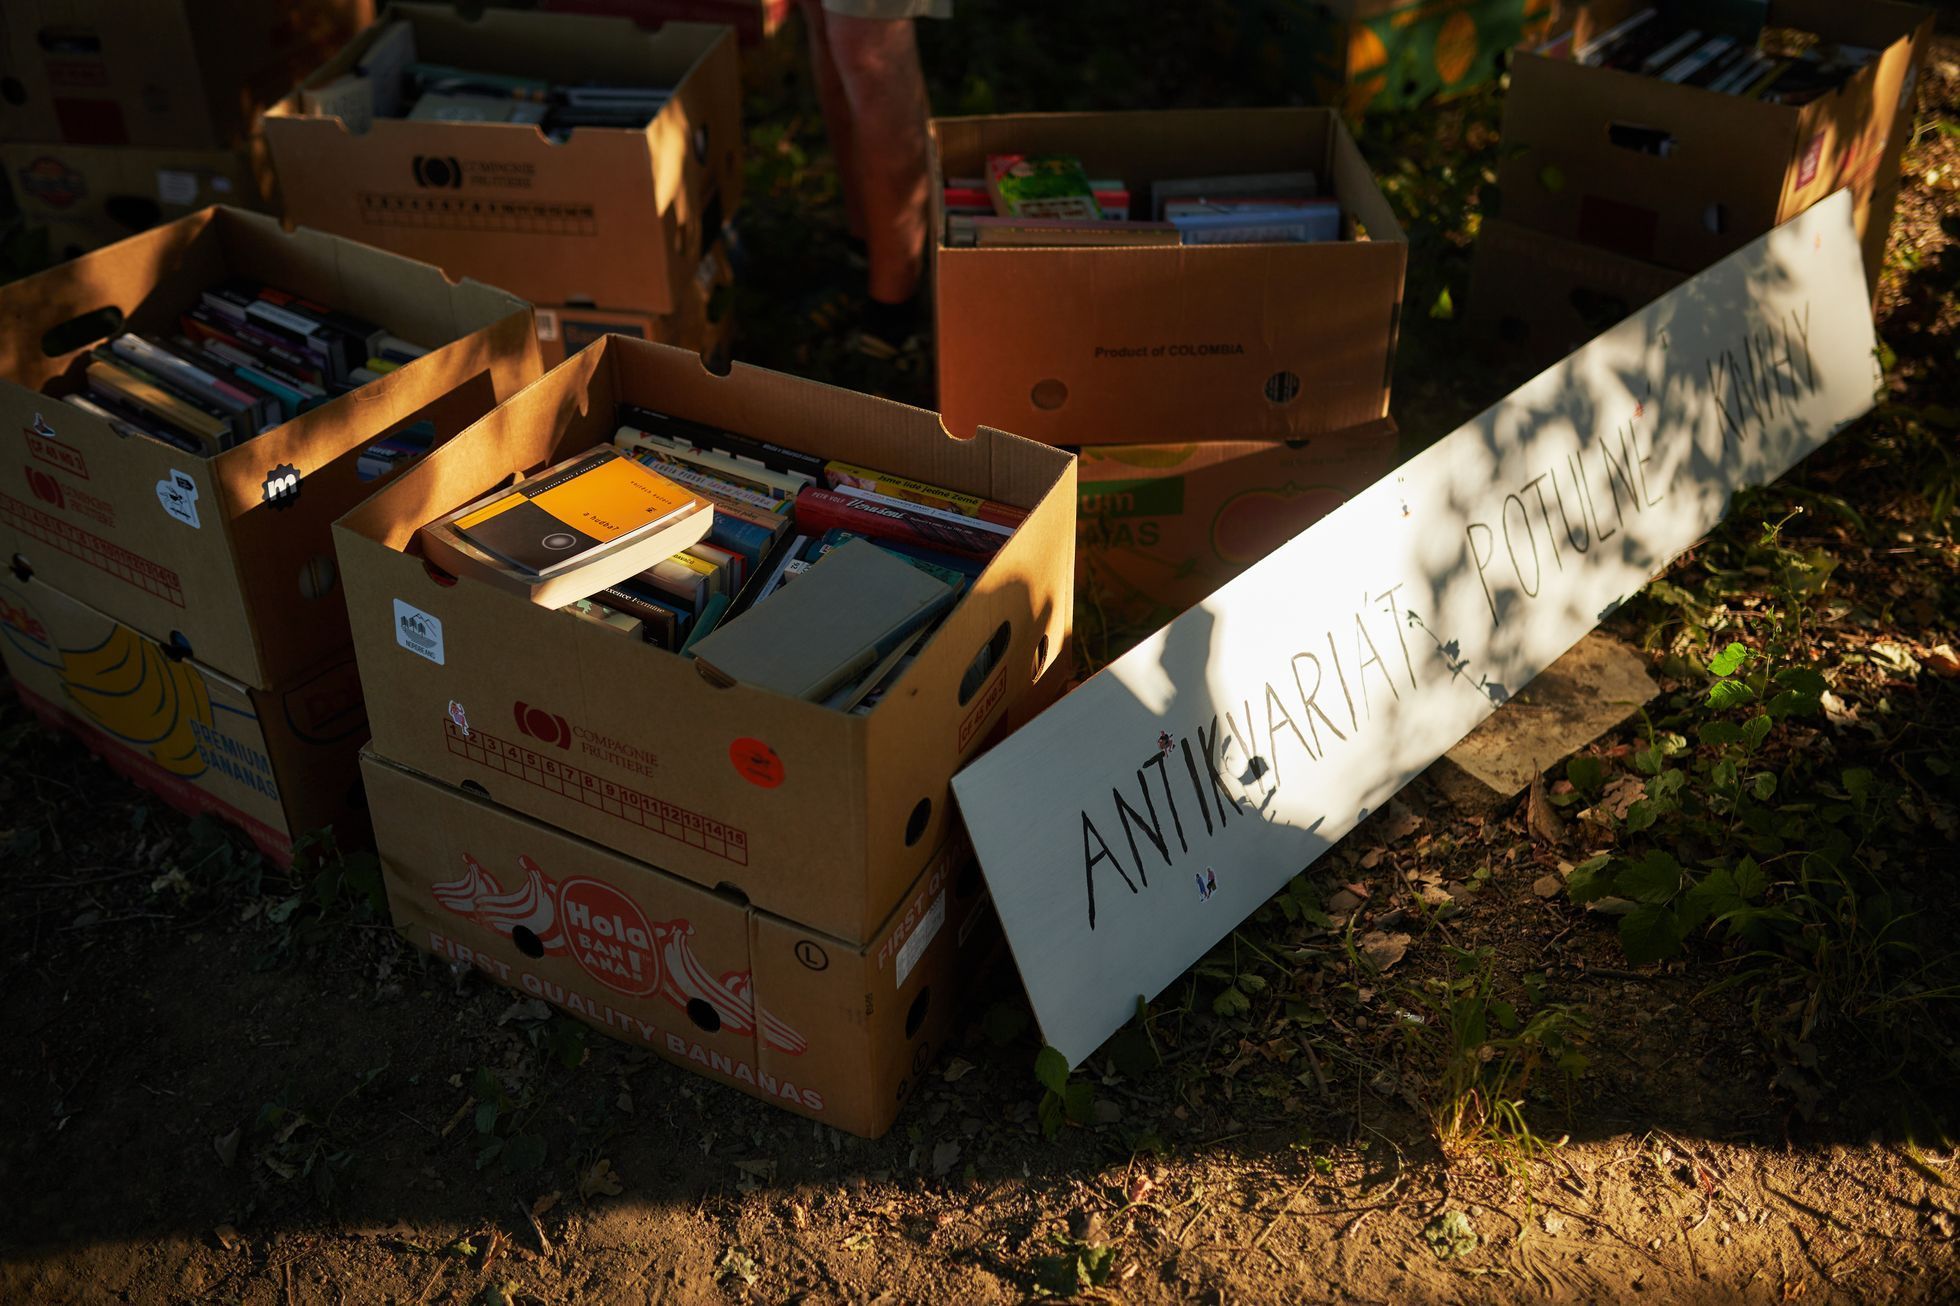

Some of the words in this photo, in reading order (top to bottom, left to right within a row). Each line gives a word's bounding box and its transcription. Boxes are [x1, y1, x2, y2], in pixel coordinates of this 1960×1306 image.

[1095, 345, 1148, 358] Product
[1152, 344, 1166, 358] of
[1168, 343, 1245, 357] COLOMBIA
[190, 719, 271, 775] PREMIUM
[198, 746, 279, 801] BANANAS
[573, 726, 659, 768] COMPAGNIE
[1081, 583, 1416, 930] ANTIKVARIÁT
[449, 724, 456, 736] 1
[469, 731, 477, 743] 2
[488, 738, 496, 750] 3
[508, 747, 517, 758] 4
[527, 754, 536, 765] 5
[546, 761, 555, 773] 6
[565, 768, 574, 779] 7
[585, 775, 593, 787] 8
[606, 784, 615, 795] 9
[621, 790, 638, 805] 10
[643, 799, 658, 813] 11
[663, 806, 680, 821] 12
[684, 813, 700, 829] 13
[705, 822, 722, 836] 14
[727, 830, 744, 845] 15
[566, 899, 650, 951] Hola
[877, 892, 925, 971] FIRST
[429, 931, 511, 981] FIRST
[521, 972, 658, 1042] QUALITY
[666, 1031, 825, 1112] BANANAS
